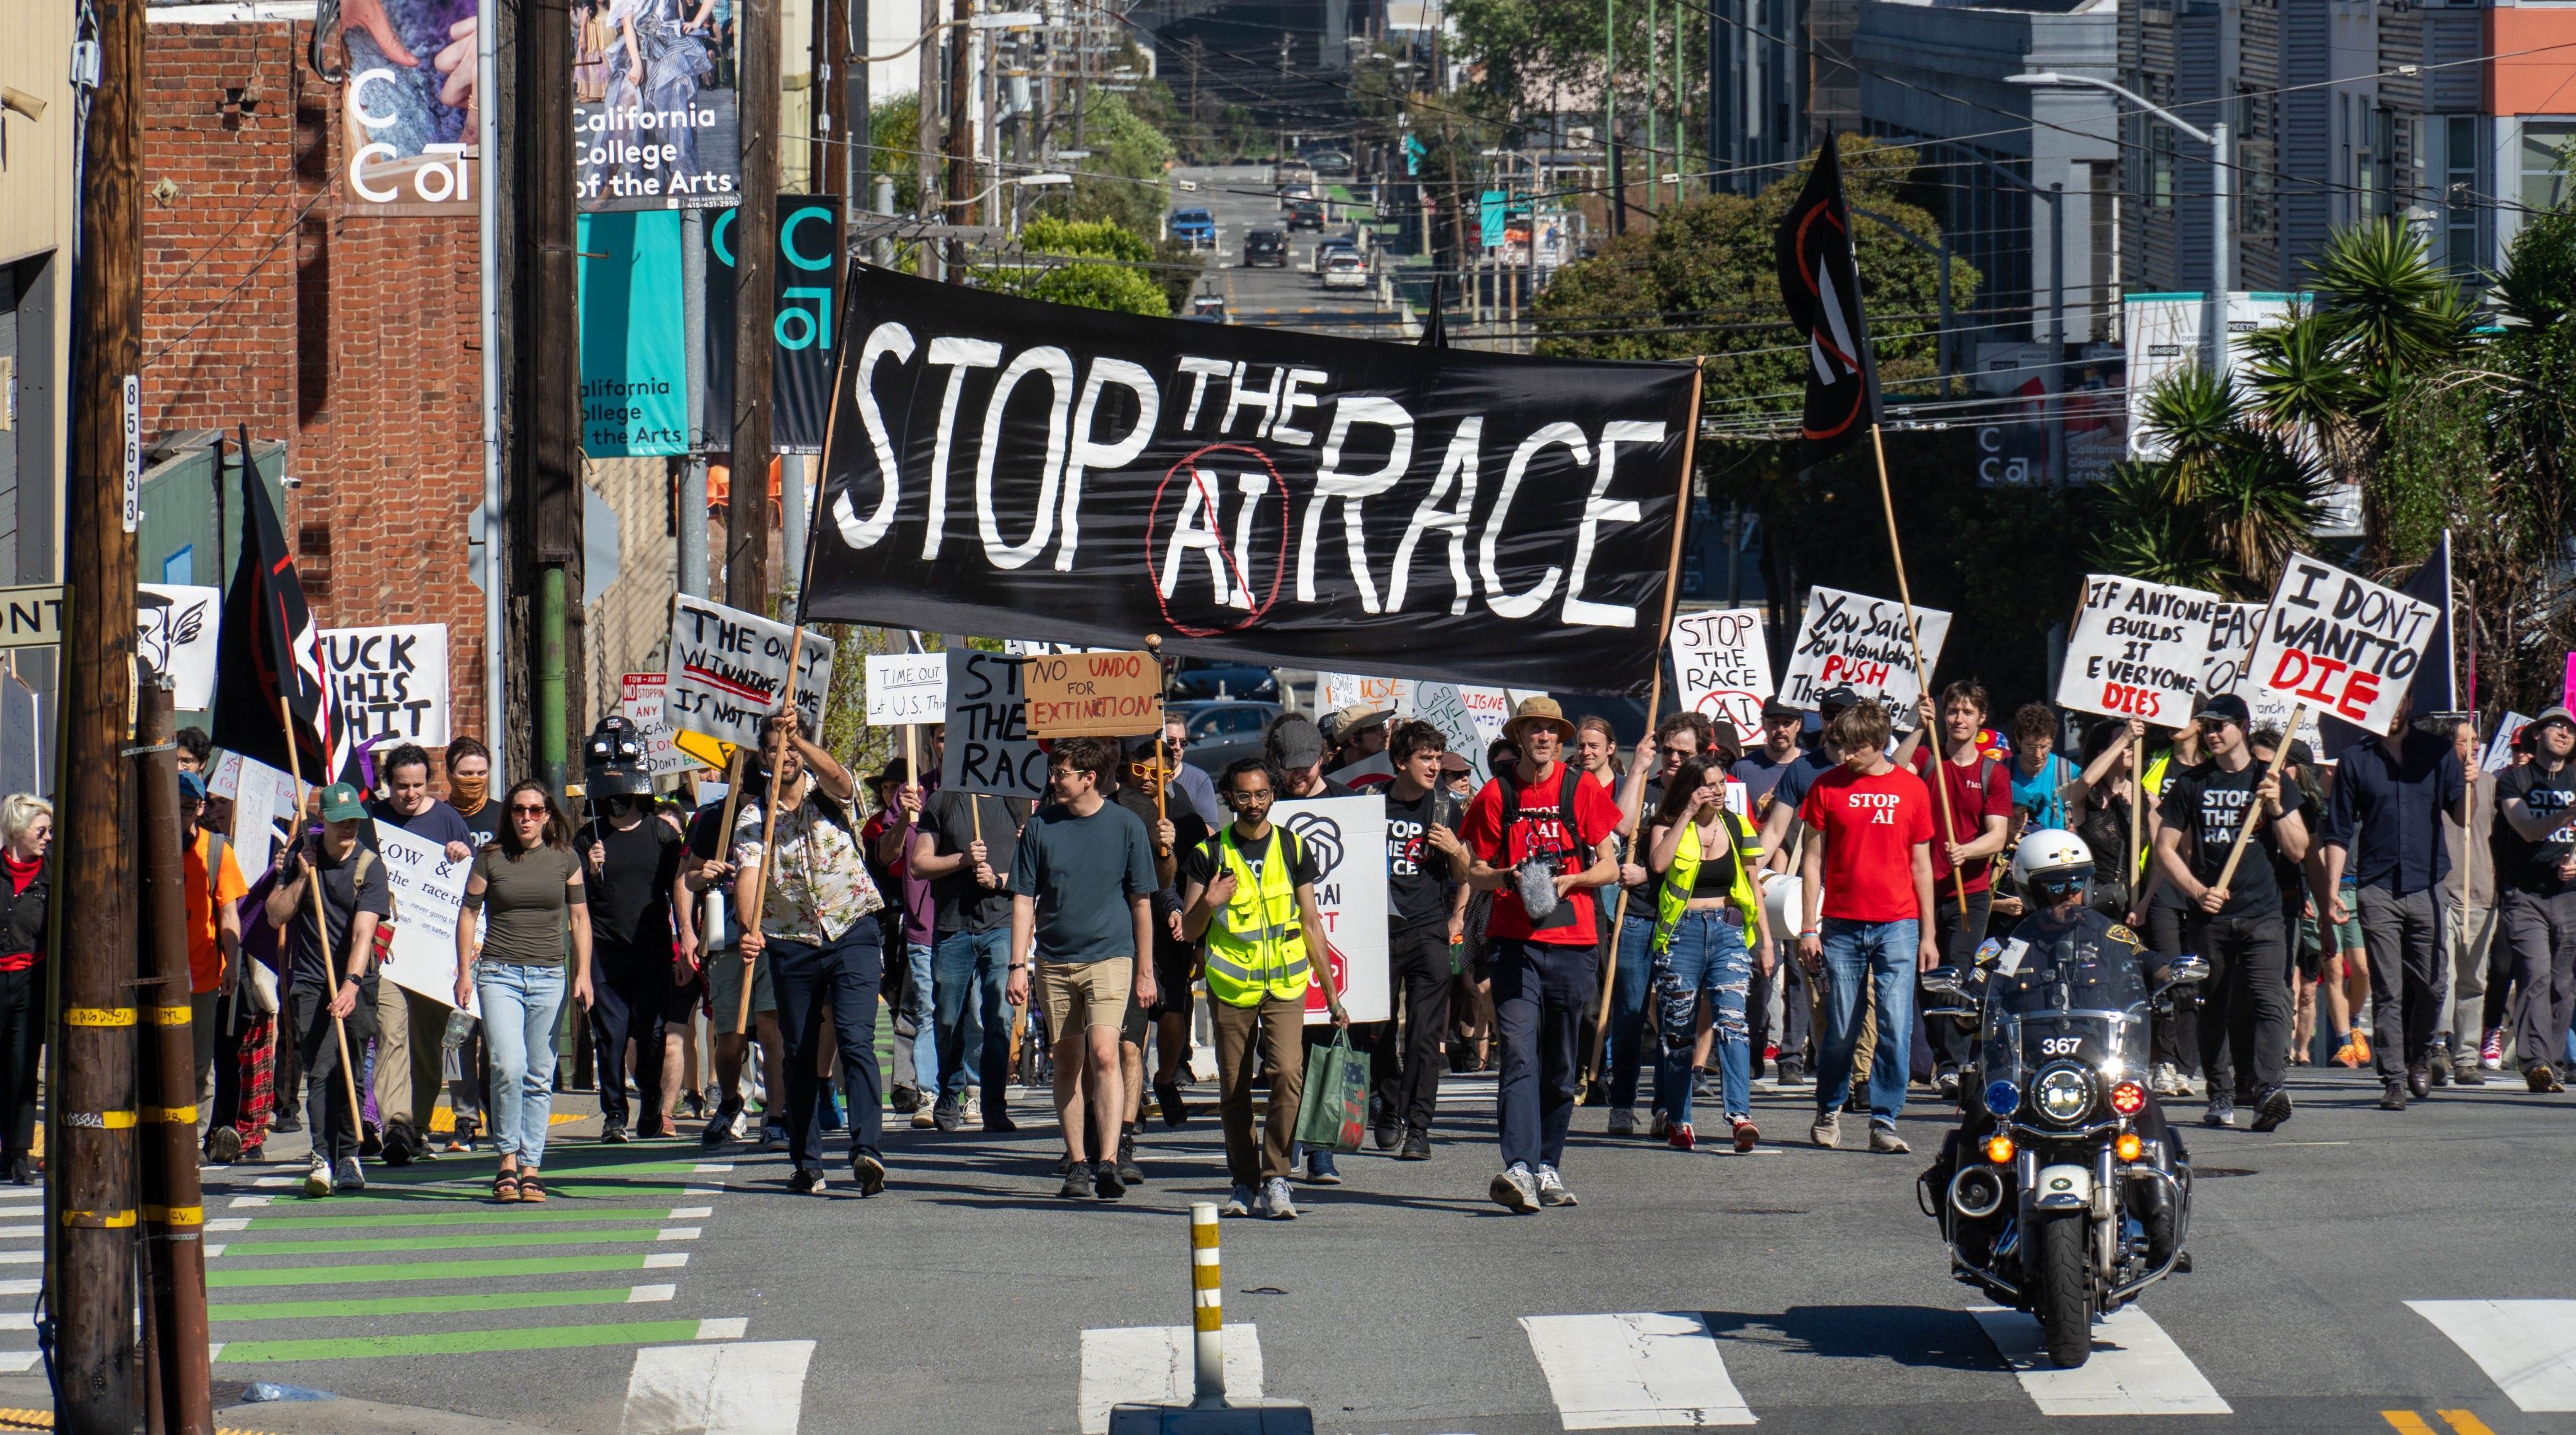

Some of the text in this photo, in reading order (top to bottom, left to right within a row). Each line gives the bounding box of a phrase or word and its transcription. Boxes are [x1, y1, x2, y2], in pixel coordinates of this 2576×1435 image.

[573, 102, 716, 133] California
[575, 139, 677, 170] College
[576, 170, 733, 198] of the Arts
[687, 200, 739, 208] 415-431-2950
[594, 427, 682, 445] the Arts
[127, 384, 136, 521] 85633
[832, 321, 1667, 628] STOP THE RACE
[1160, 469, 1270, 610] AI
[2087, 581, 2218, 624] IF ANYONE
[2287, 564, 2432, 645] I DON'T
[682, 605, 756, 654] THE
[1678, 614, 1755, 648] STOP
[1813, 592, 1922, 643] You Said
[2106, 616, 2185, 643] BUILDS
[320, 634, 416, 673] UCK
[1797, 628, 1929, 674] You Wouldn
[2121, 640, 2153, 662] IT
[2273, 607, 2418, 680] WANT TO
[680, 642, 779, 692] WINNING
[1032, 656, 1141, 684] NO UNDO
[1695, 649, 1746, 667] THE
[1820, 654, 1890, 687] PUSH
[333, 672, 410, 703] HIS
[880, 666, 941, 684] TIME OUT
[1068, 681, 1096, 695] FOR
[1687, 668, 1757, 691] RACE
[1790, 674, 1826, 703] The
[2268, 647, 2381, 721] DIE
[623, 684, 665, 699] NO STOPPIN
[1417, 680, 1452, 710] Can
[2101, 681, 2162, 718] DIES
[636, 706, 657, 717] ANY
[674, 688, 709, 713] IS
[713, 700, 746, 729] NOT
[870, 699, 885, 715] Let
[1034, 695, 1153, 725] EXTINCTION
[1713, 698, 1755, 726] AI
[2256, 698, 2285, 714] anch
[956, 702, 1027, 741] THE
[1465, 734, 1474, 742] to
[1849, 793, 1900, 808] STOP
[2203, 790, 2255, 807] STOP
[2529, 789, 2576, 806] STOP
[1539, 822, 1560, 837] AI
[1871, 809, 1894, 824] AI
[2201, 809, 2241, 826] THE
[435, 861, 453, 879] &
[387, 870, 409, 887] the
[421, 883, 448, 901] race
[411, 902, 430, 913] never
[430, 910, 448, 922] going
[449, 917, 455, 925] to
[431, 925, 452, 939] safety
[2042, 1037, 2082, 1055] 367
